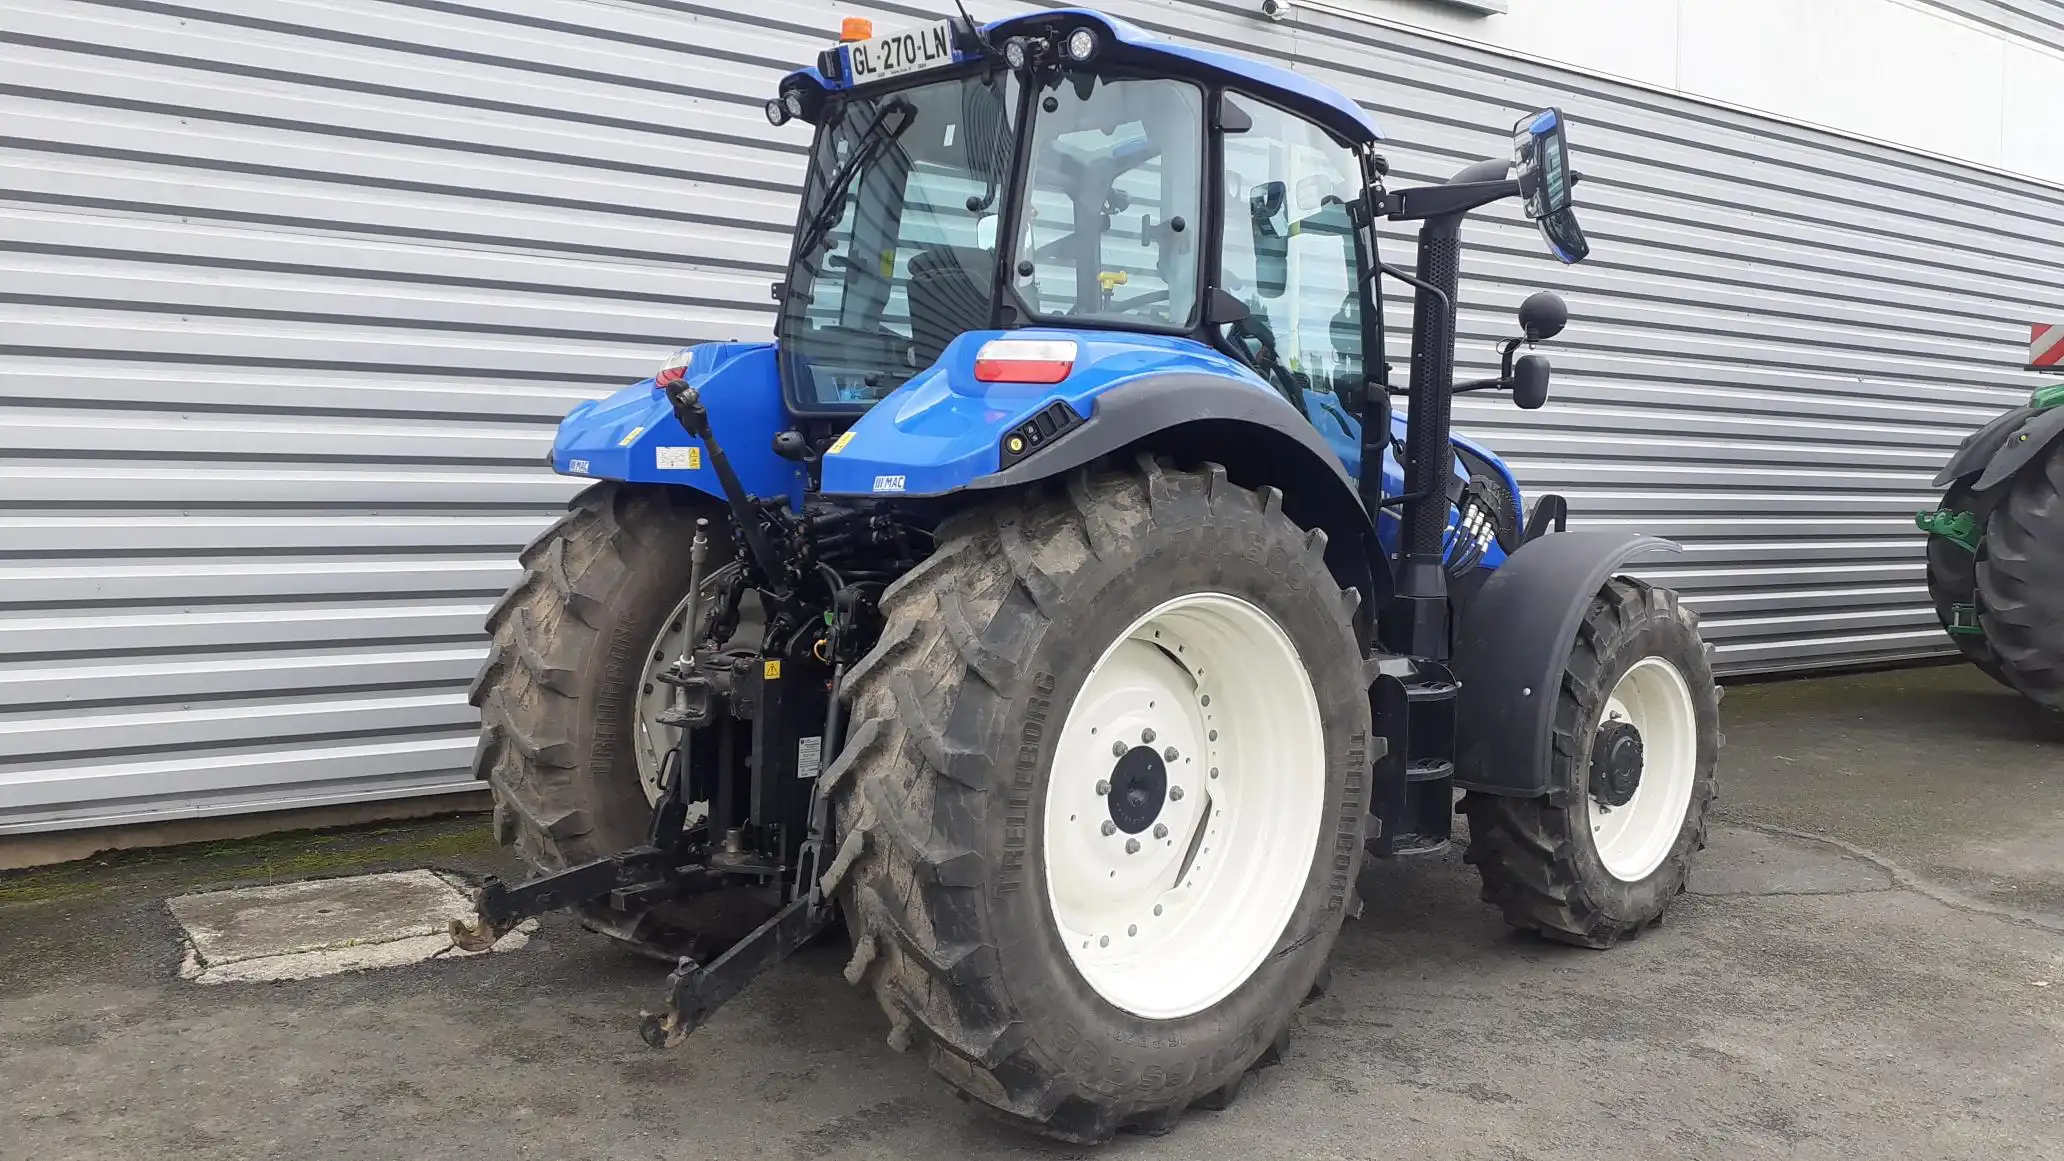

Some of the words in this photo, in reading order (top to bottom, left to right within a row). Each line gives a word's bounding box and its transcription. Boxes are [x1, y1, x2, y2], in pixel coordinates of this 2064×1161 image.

[853, 26, 947, 76] GL-270-LN
[885, 477, 904, 488] MAC
[997, 671, 1055, 898] TRELLEBORG
